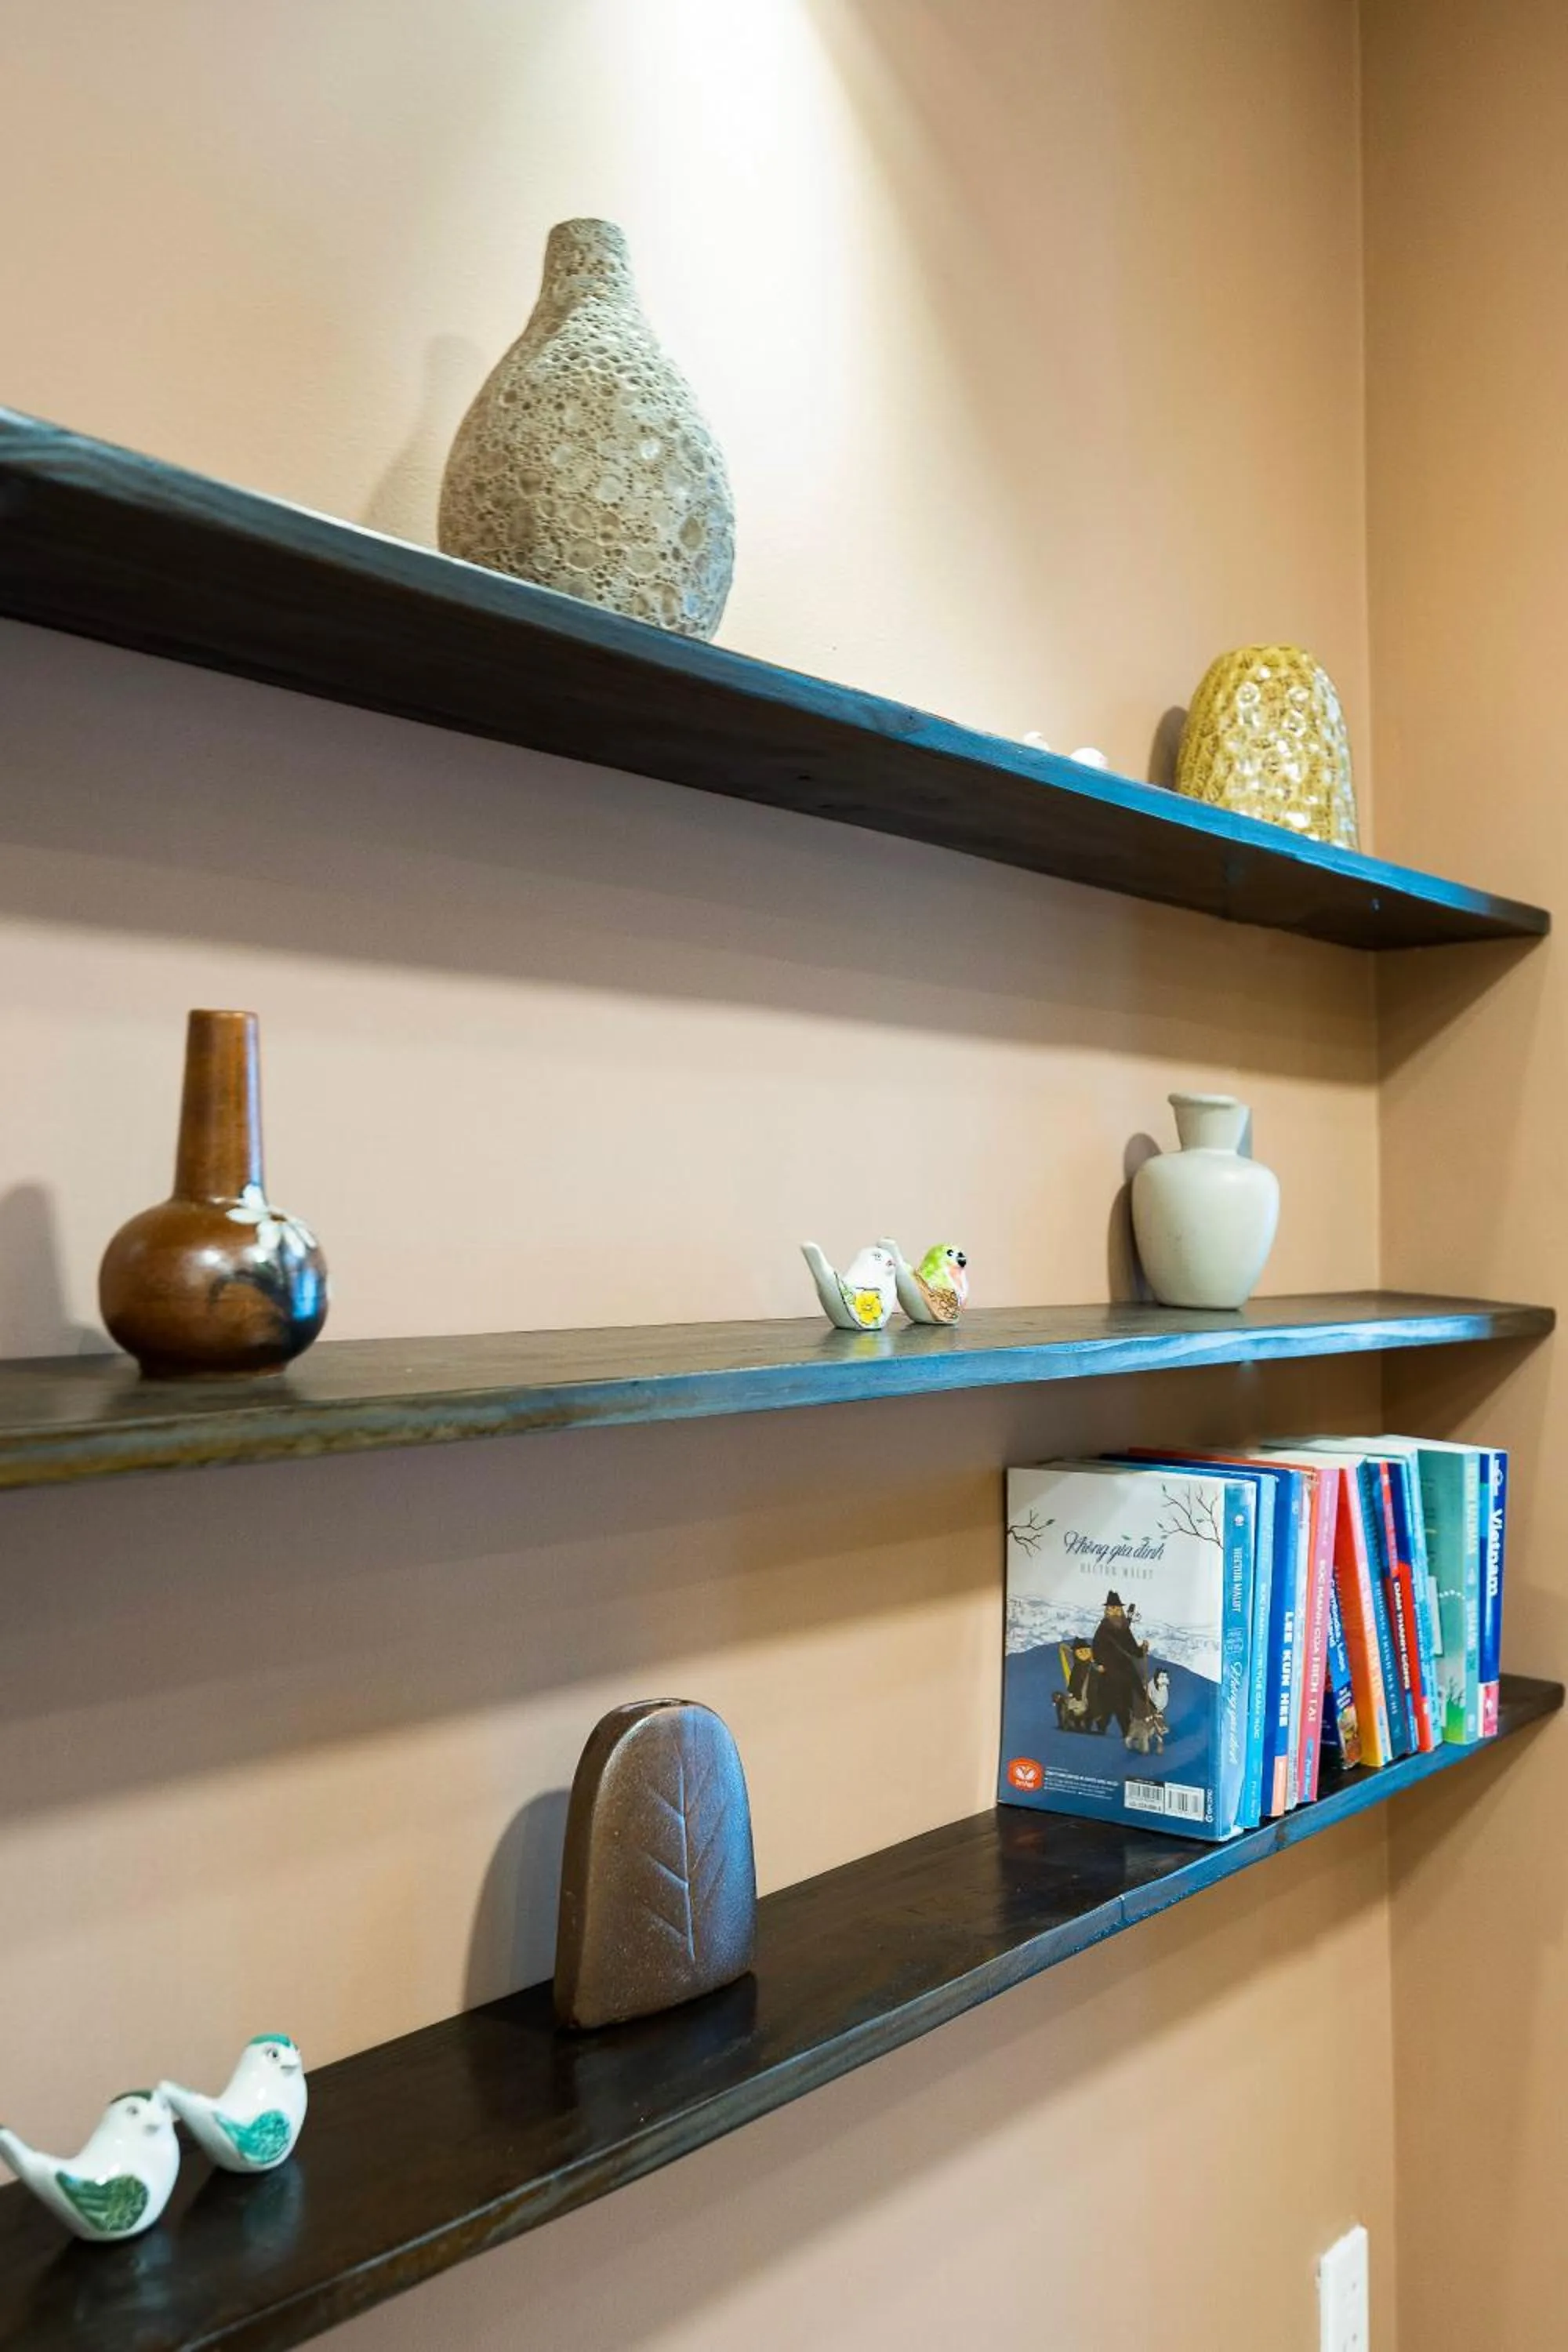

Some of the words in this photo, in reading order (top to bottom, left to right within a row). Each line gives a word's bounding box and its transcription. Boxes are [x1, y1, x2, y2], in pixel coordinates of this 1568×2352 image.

[1490, 1508, 1504, 1598] Vietnam
[1284, 1612, 1294, 1643] LEE
[1281, 1650, 1292, 1686] KUN
[1279, 1693, 1290, 1726] HEE
